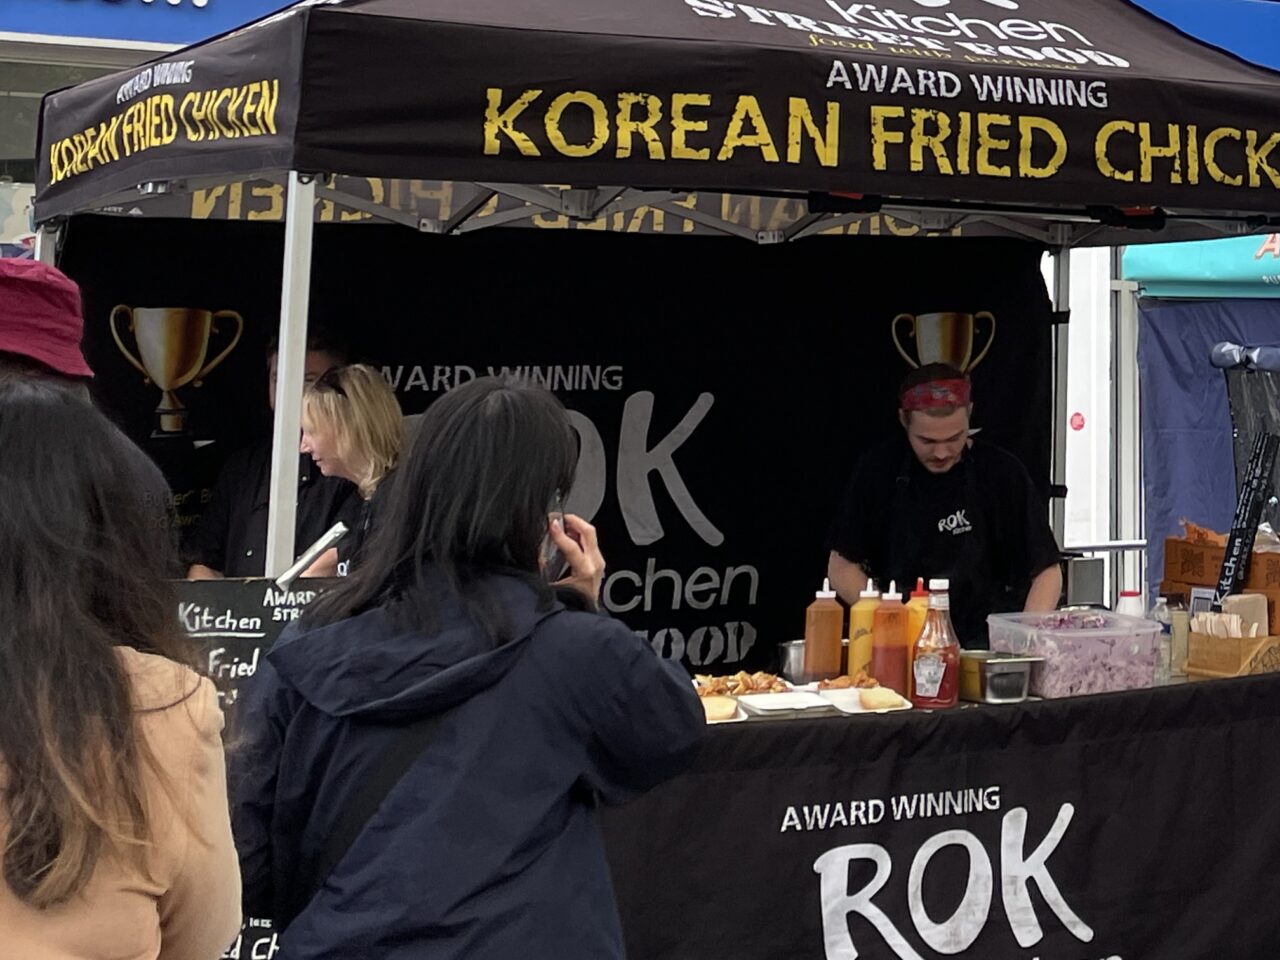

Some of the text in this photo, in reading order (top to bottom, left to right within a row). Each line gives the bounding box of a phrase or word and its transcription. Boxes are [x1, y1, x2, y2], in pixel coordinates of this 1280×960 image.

[826, 0, 1095, 47] Kitchen
[116, 67, 151, 104] AWARD
[825, 60, 1109, 108] AWARD WINNING
[49, 79, 279, 186] KOREAN FRIED CHICKEN
[483, 88, 840, 167] KOREAN
[870, 105, 1068, 179] FRIED
[380, 365, 476, 392] WARD
[937, 509, 971, 532] ROK
[602, 558, 760, 612] chen
[1213, 538, 1242, 607] Kitchen
[178, 602, 262, 632] Kitchen
[272, 607, 305, 622] STR
[208, 647, 261, 678] Fried
[634, 621, 757, 666] OOD
[780, 786, 1001, 832] AWARD WINNING
[813, 803, 1095, 960] ROK
